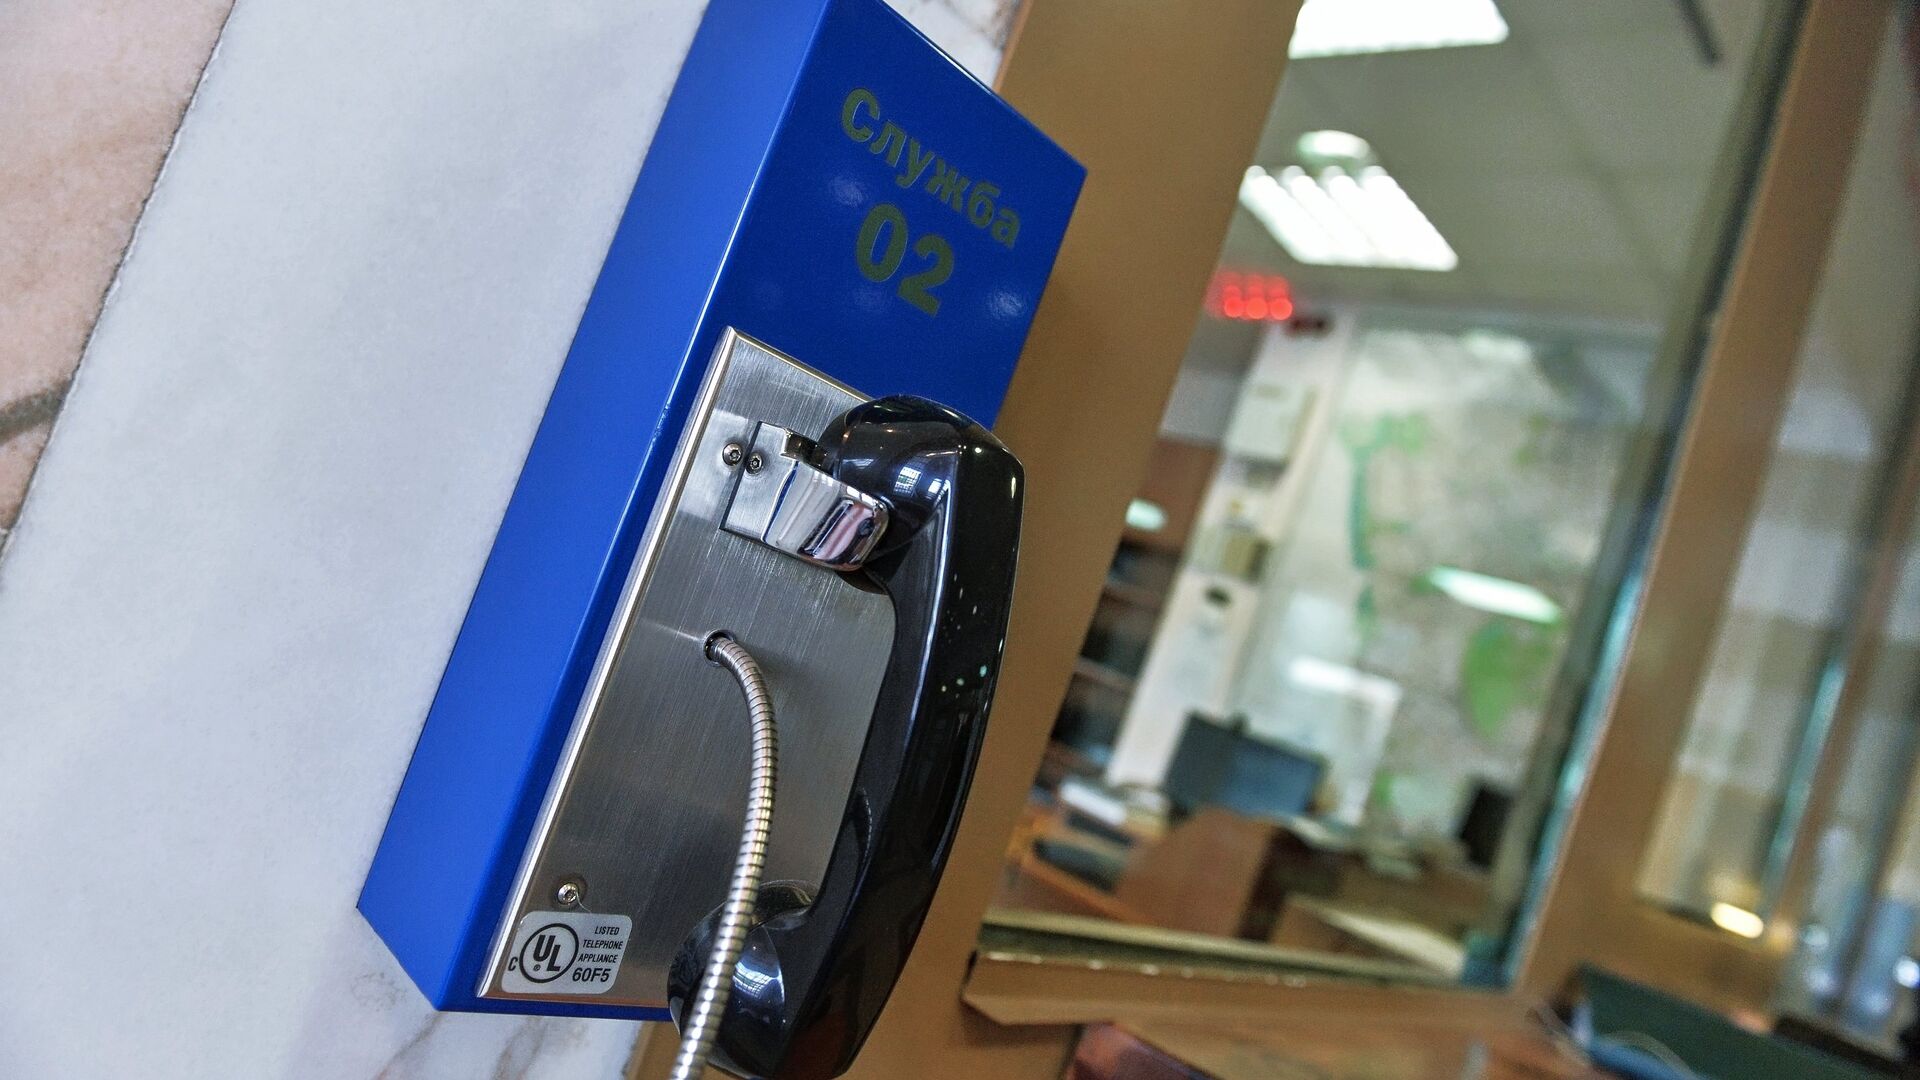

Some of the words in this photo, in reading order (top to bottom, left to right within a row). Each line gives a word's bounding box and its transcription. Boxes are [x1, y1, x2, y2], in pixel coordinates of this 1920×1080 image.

[841, 88, 1020, 249] Служба
[855, 203, 954, 317] 02
[594, 926, 619, 935] LISTED
[582, 939, 623, 949] TELEPHONE
[577, 953, 617, 963] APPLIANCE
[572, 967, 611, 982] 60F5
